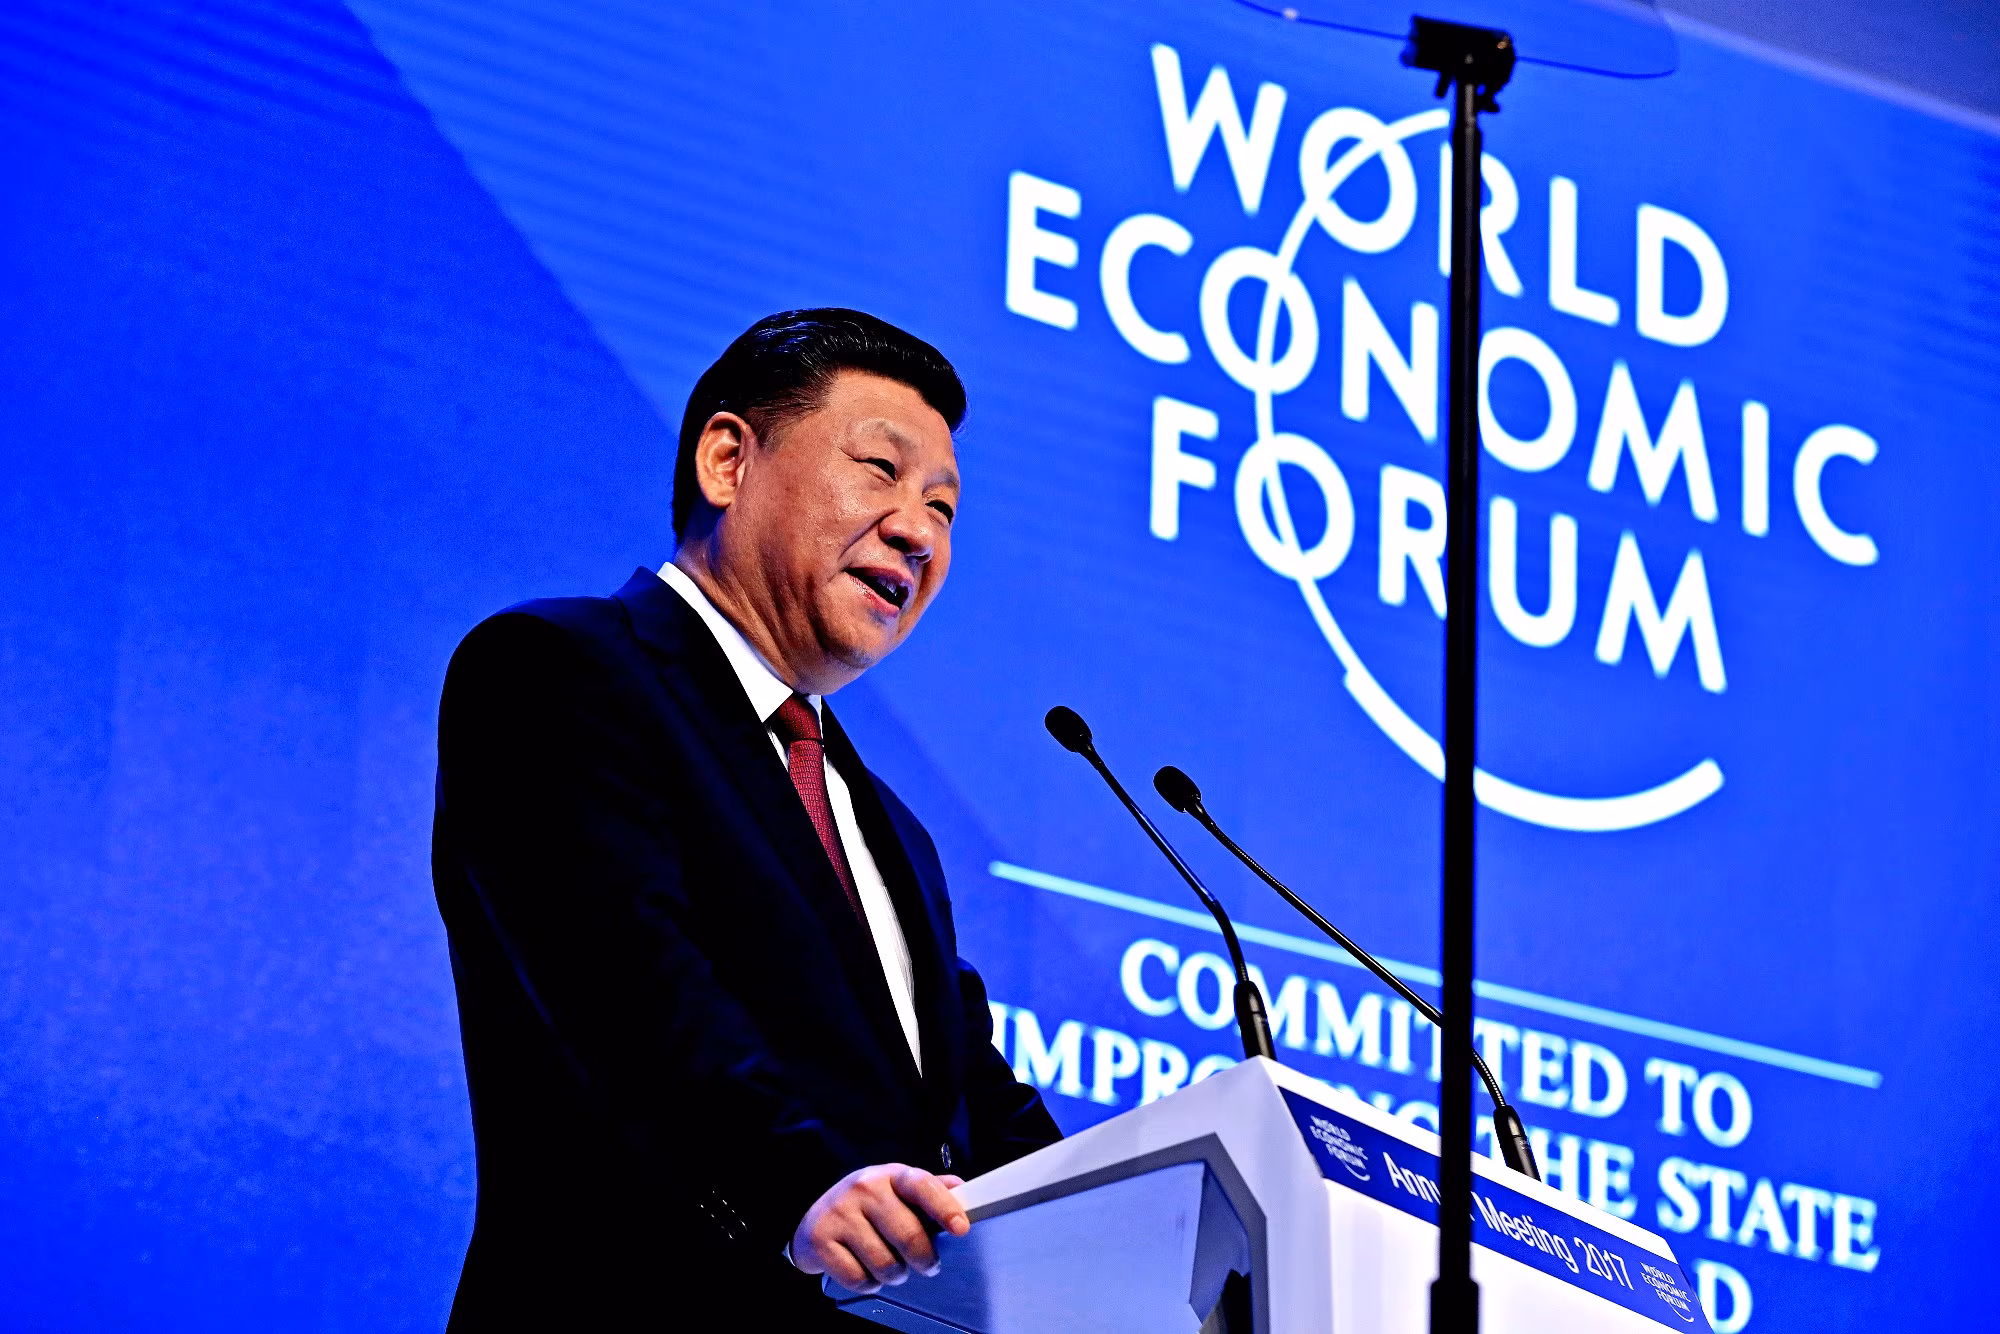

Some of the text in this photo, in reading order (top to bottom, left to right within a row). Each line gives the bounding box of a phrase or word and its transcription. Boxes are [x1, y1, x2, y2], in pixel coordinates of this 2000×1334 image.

[1152, 43, 1729, 348] WORLD
[1005, 171, 1879, 567] ECONOMIC
[1149, 395, 1727, 693] FORUM
[1645, 1057, 1752, 1148] TO
[1470, 1190, 1580, 1274] Meeting
[1574, 1236, 1635, 1290] 2017
[1656, 1156, 1881, 1273] STATE
[1640, 1261, 1675, 1285] WORLD
[1640, 1271, 1692, 1303] ECONOMIC
[1655, 1288, 1691, 1312] FORUM
